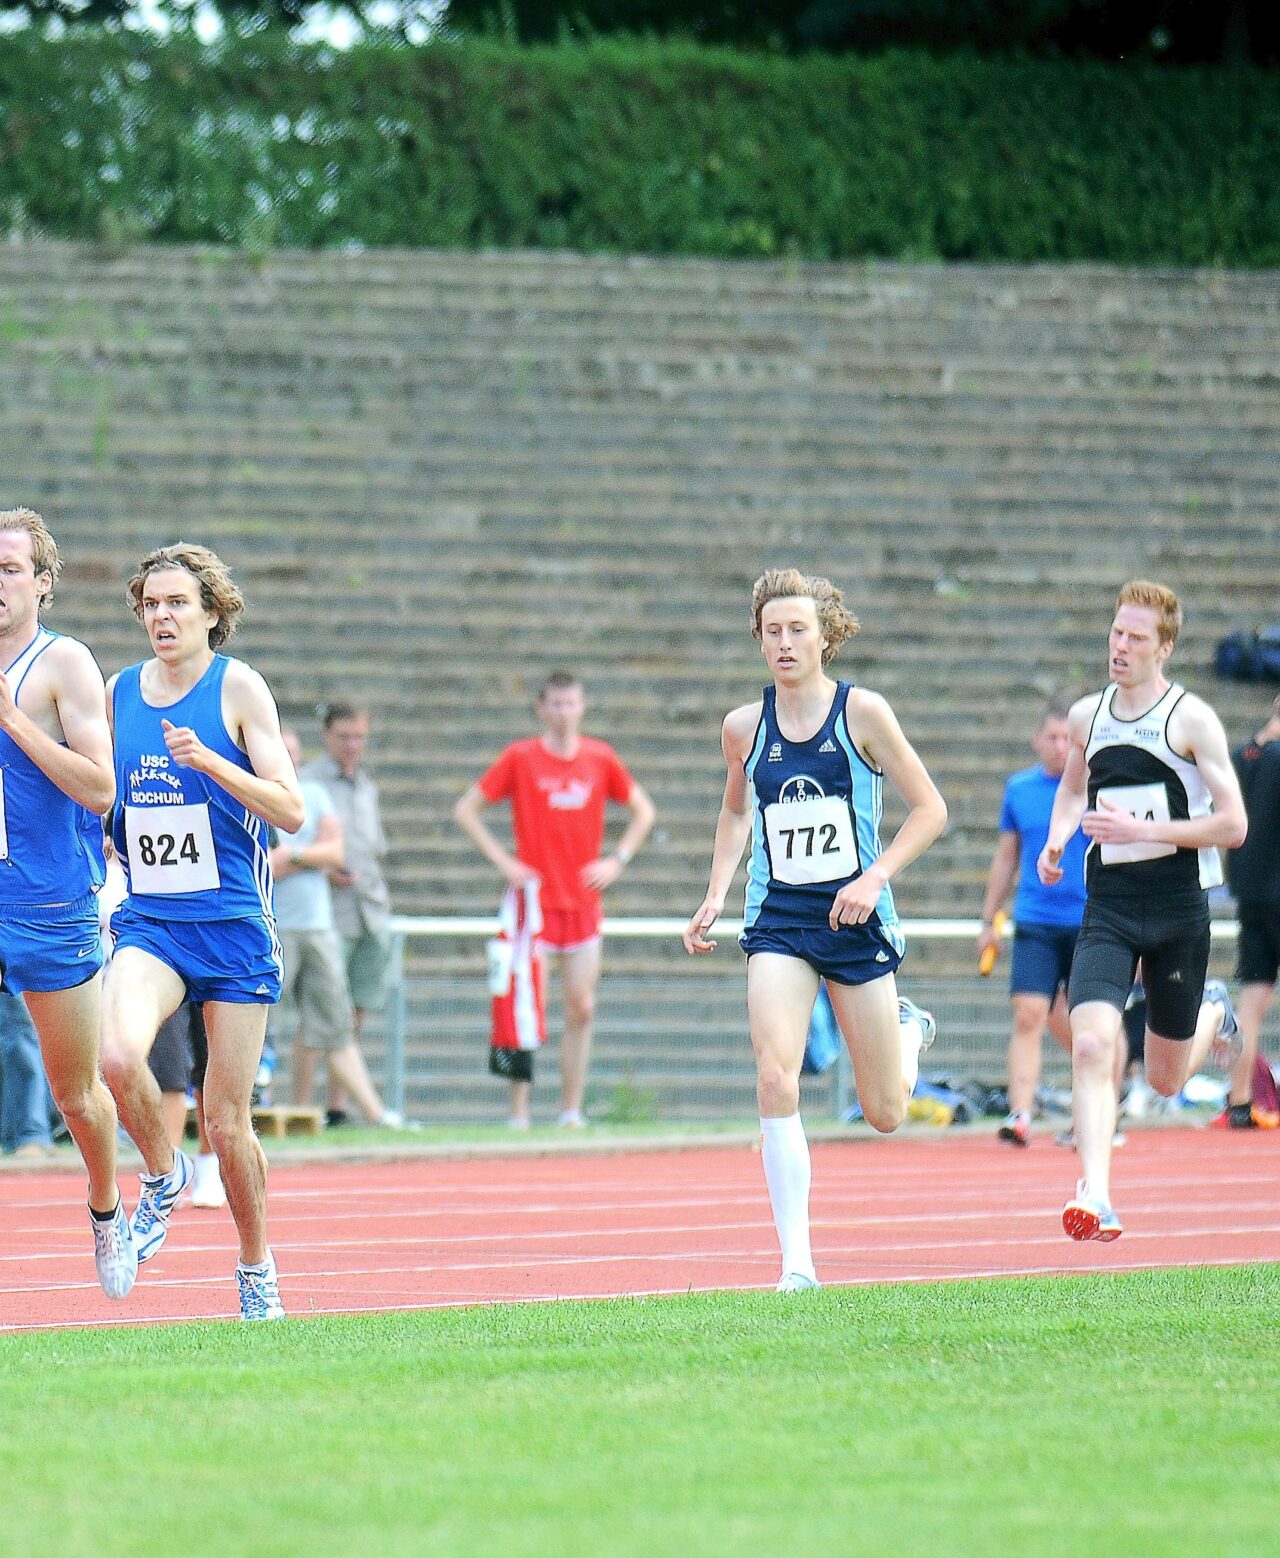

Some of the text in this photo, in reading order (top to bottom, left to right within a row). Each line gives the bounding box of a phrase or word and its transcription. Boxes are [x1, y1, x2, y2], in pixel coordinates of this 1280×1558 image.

[140, 754, 169, 768] USC
[131, 791, 184, 805] BOCHUM
[138, 832, 200, 867] 824
[779, 823, 840, 860] 772
